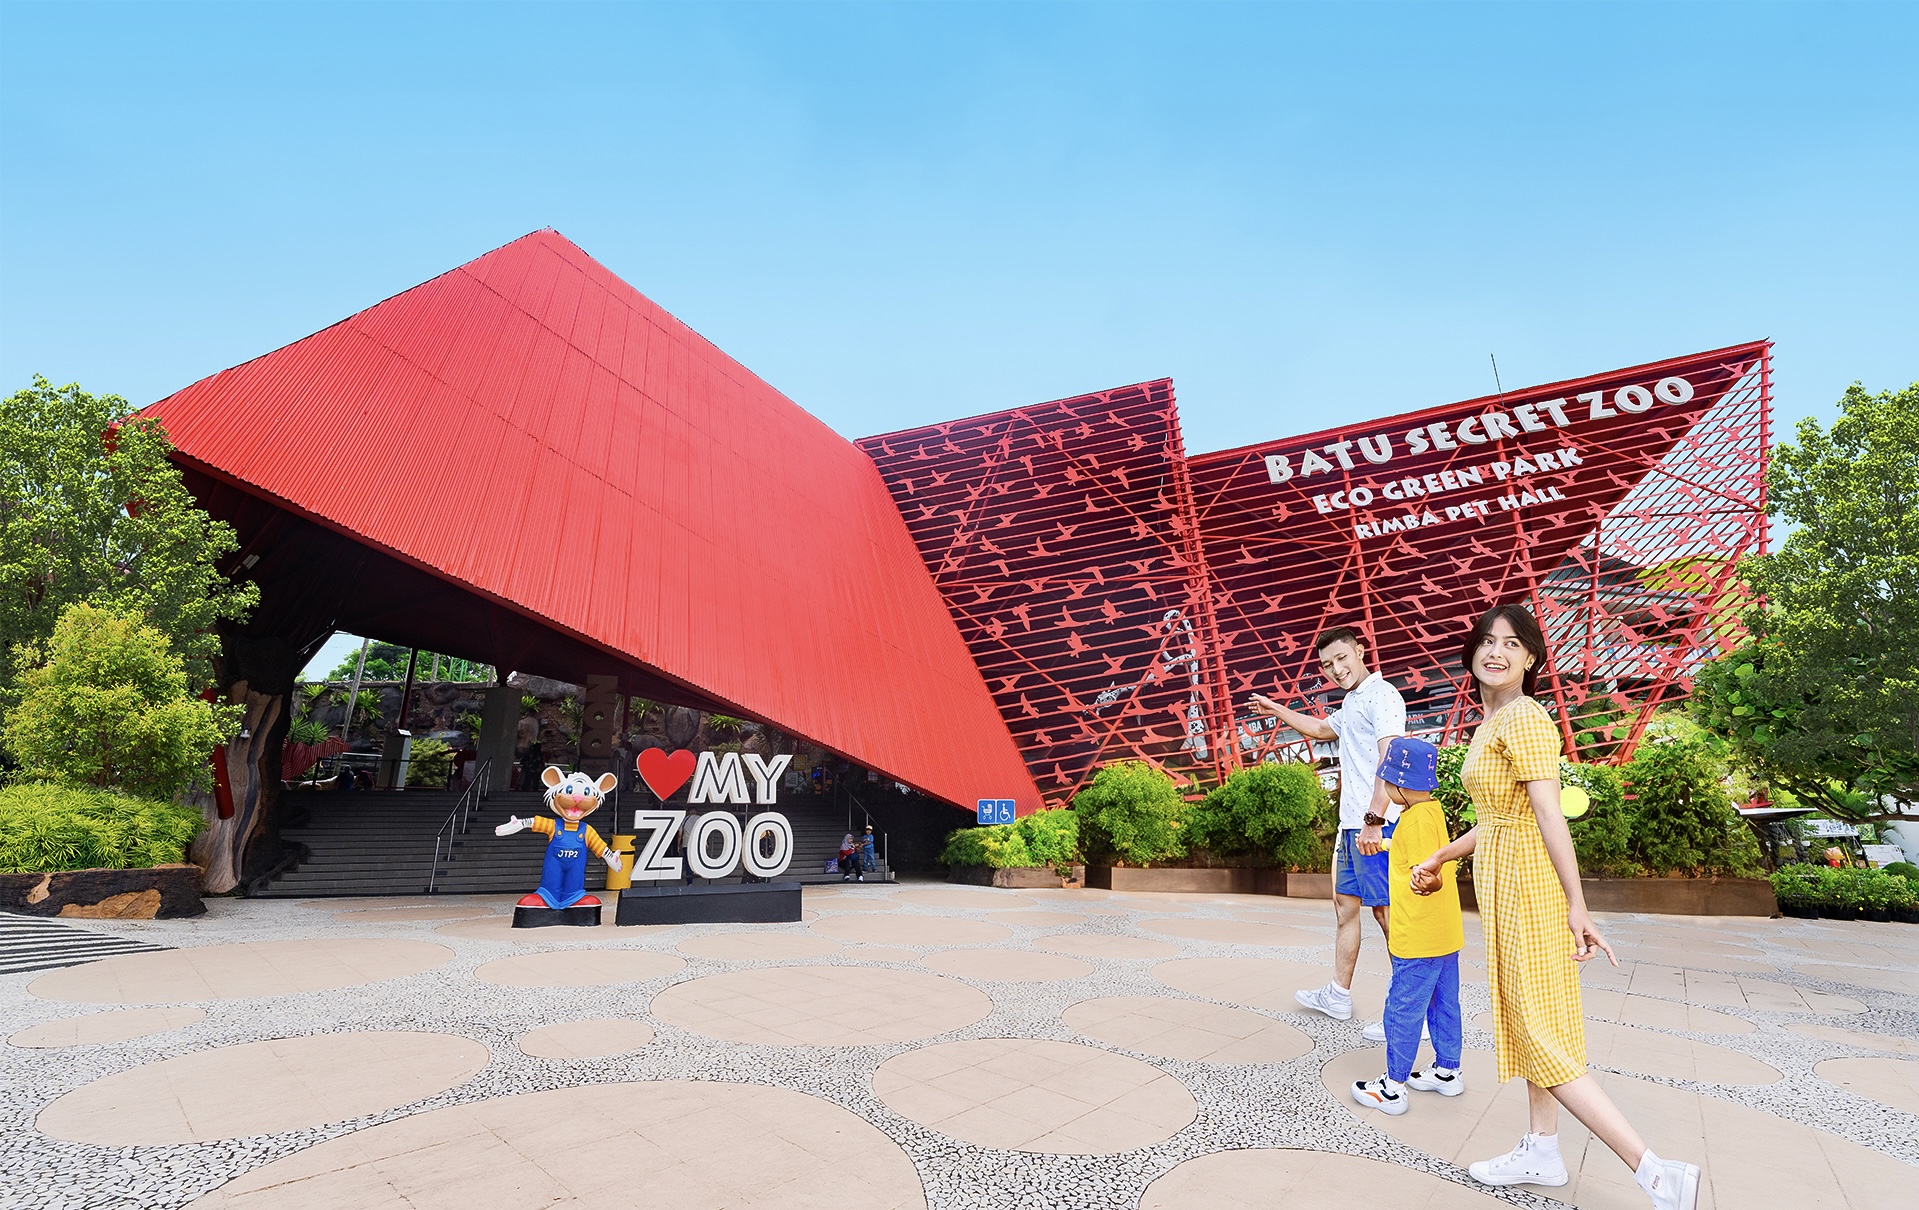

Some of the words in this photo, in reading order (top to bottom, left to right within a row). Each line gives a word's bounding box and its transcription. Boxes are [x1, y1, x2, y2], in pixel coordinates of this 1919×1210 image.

[1264, 433, 1393, 485] BATU
[1404, 398, 1571, 456] SECRET
[1576, 376, 1695, 420] ZOO
[1312, 486, 1374, 514] ECO
[1382, 465, 1484, 500] GREEN
[1490, 447, 1584, 481] PARK
[1354, 510, 1440, 539] RIMBA
[1445, 500, 1489, 522] PET
[1497, 485, 1566, 511] HALL
[687, 751, 794, 804] MY
[557, 849, 579, 859] JTP2
[629, 809, 794, 881] ZOO
